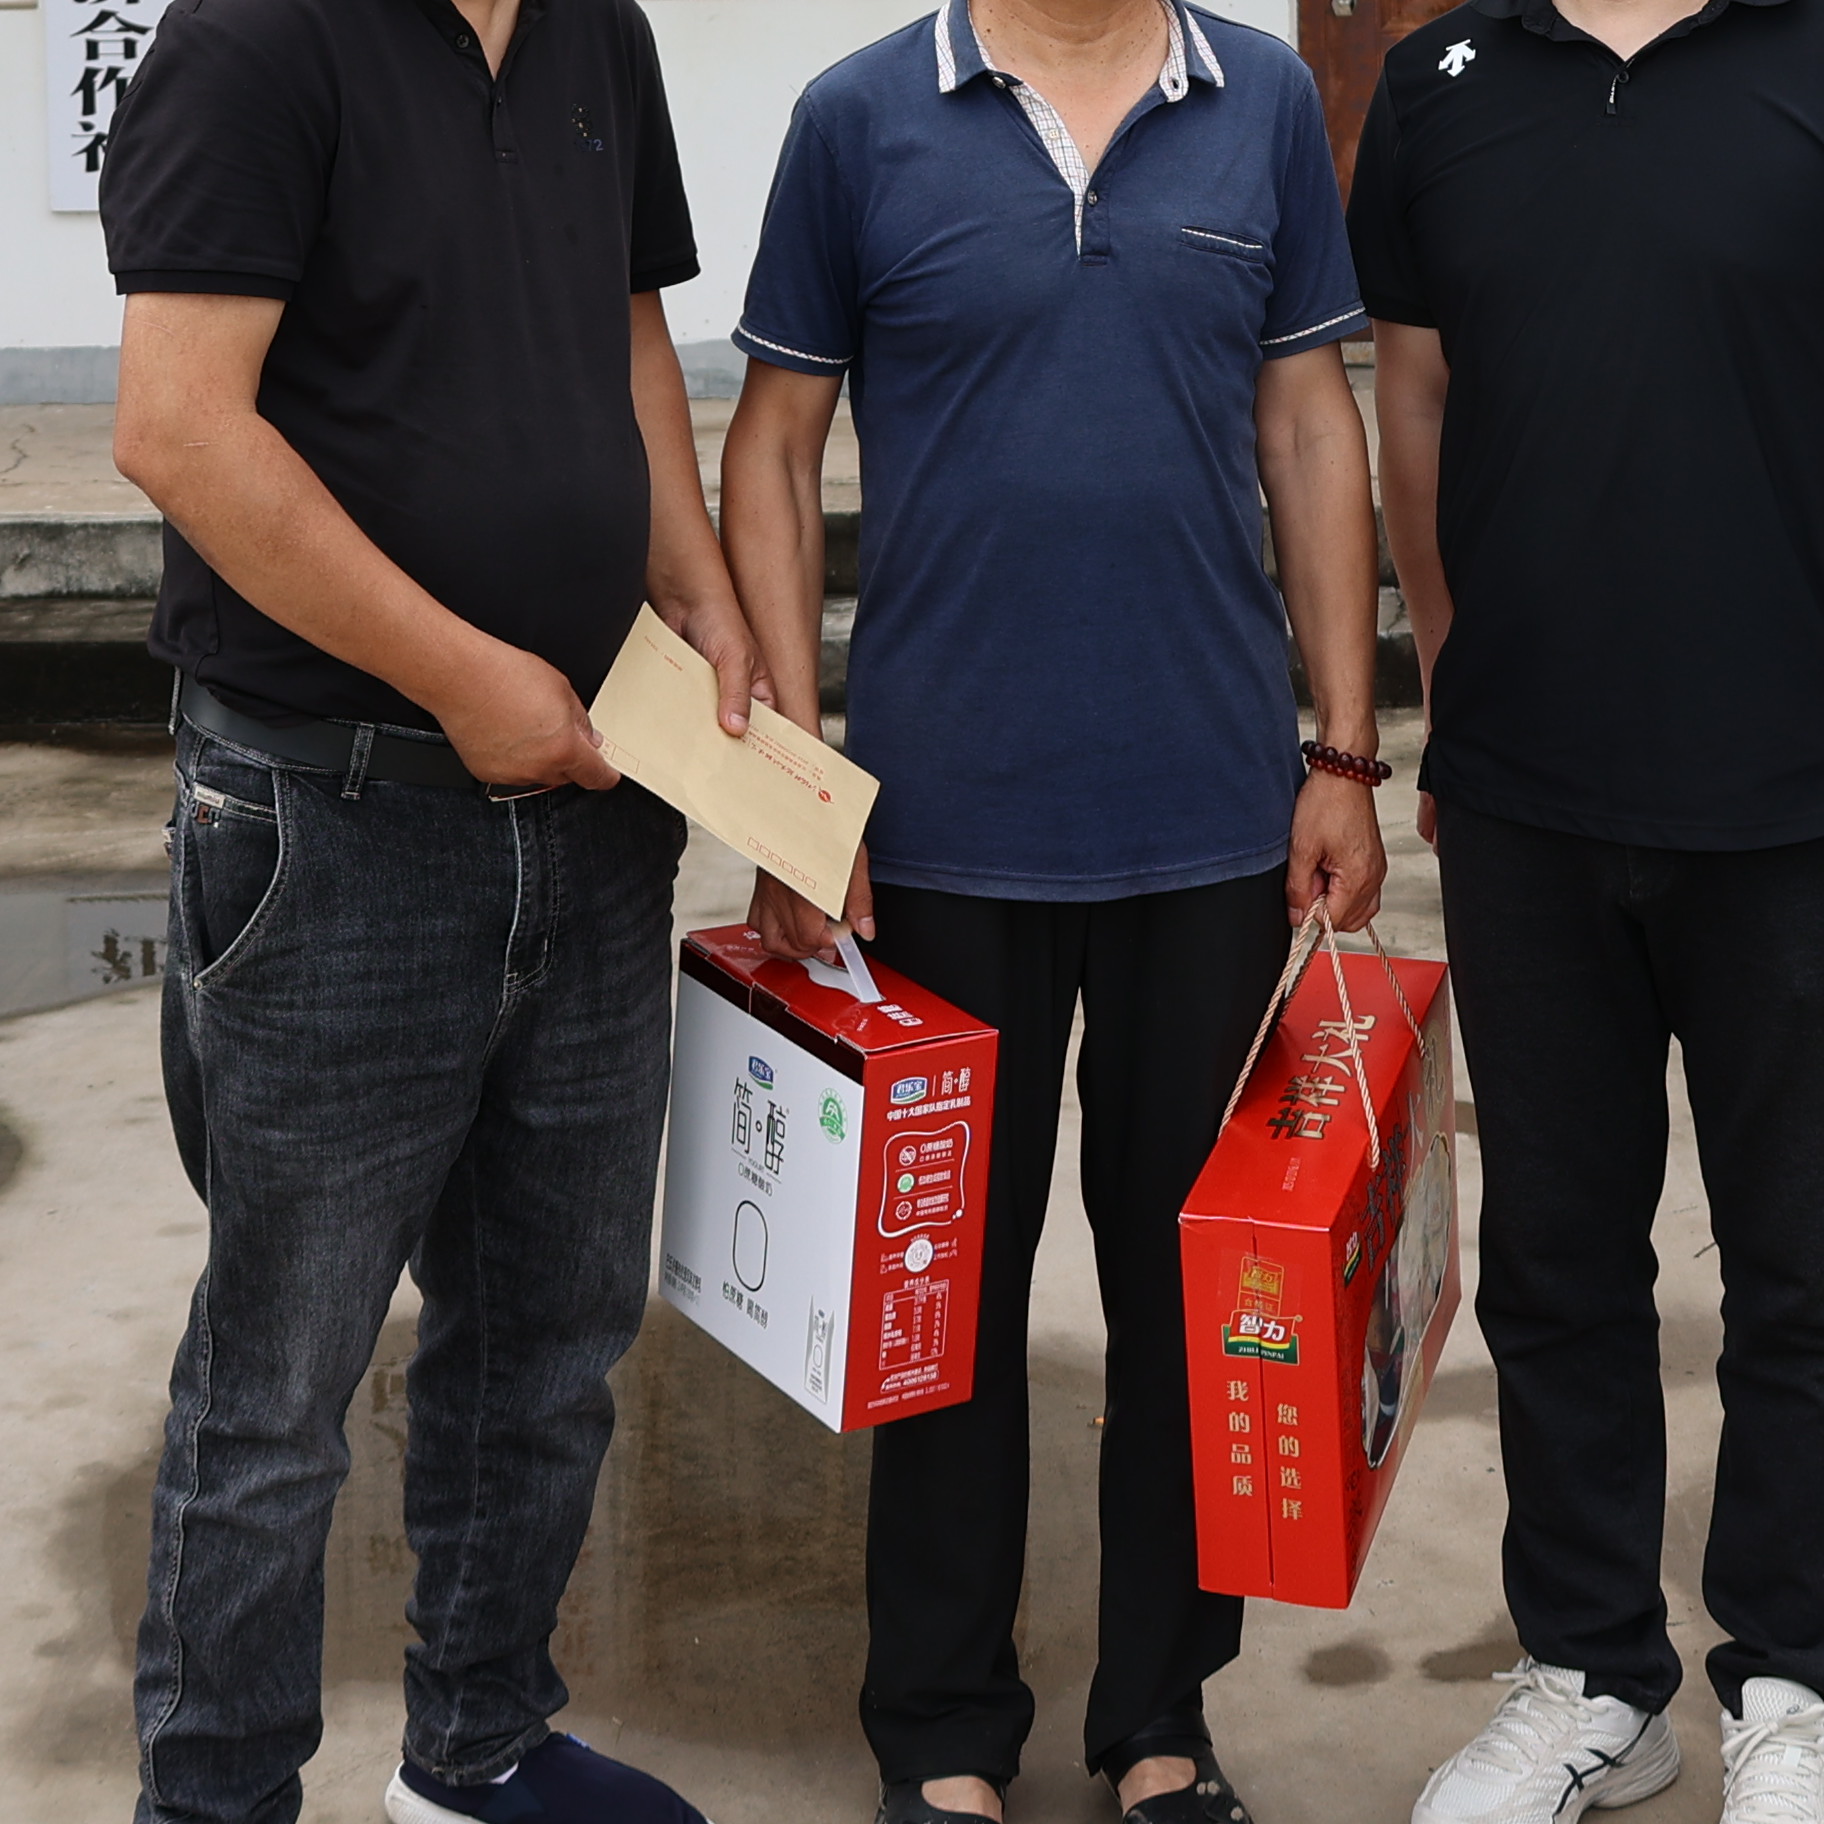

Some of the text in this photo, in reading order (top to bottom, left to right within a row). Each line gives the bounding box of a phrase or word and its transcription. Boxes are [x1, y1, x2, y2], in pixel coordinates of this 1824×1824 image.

[1266, 1014, 1377, 1141] 吉祥大礼
[1239, 1313, 1286, 1342] 智力
[1226, 1380, 1253, 1497] 我的品质
[1277, 1403, 1303, 1521] 您的选择
